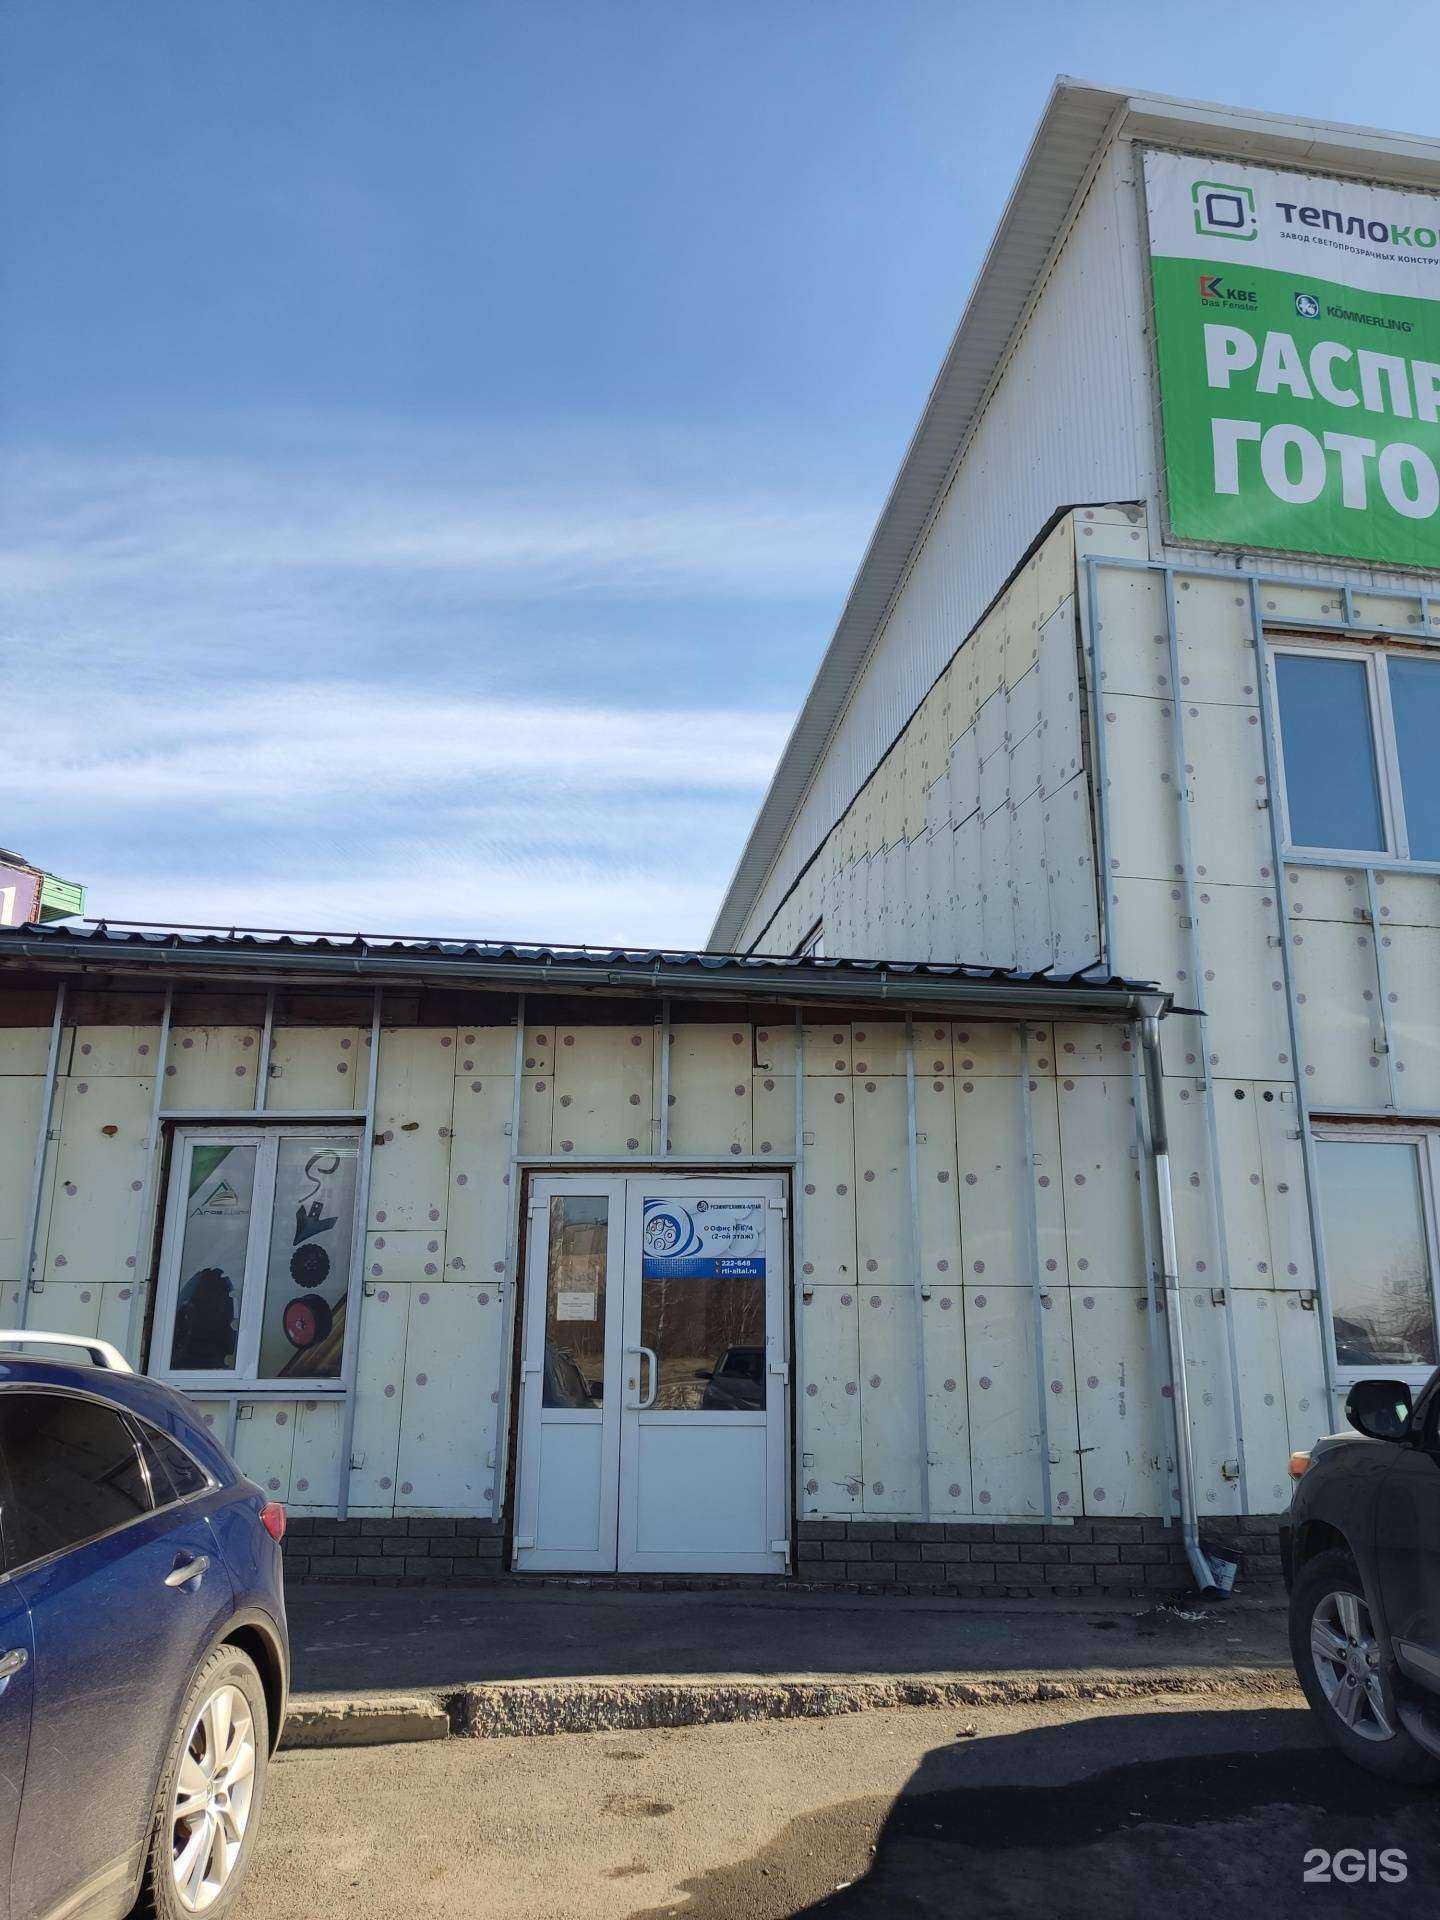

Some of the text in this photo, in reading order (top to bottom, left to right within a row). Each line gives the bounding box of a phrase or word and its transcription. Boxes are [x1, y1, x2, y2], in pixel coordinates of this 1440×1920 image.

[1275, 202, 1440, 248] теплоко
[1279, 231, 1311, 244] ЗАВОД
[1312, 237, 1396, 262] СВЕТОПРОЗРАЧНЫХ
[1201, 298, 1259, 312] Das Fenster
[1226, 288, 1257, 303] KBE
[1211, 417, 1439, 519] ГОТО
